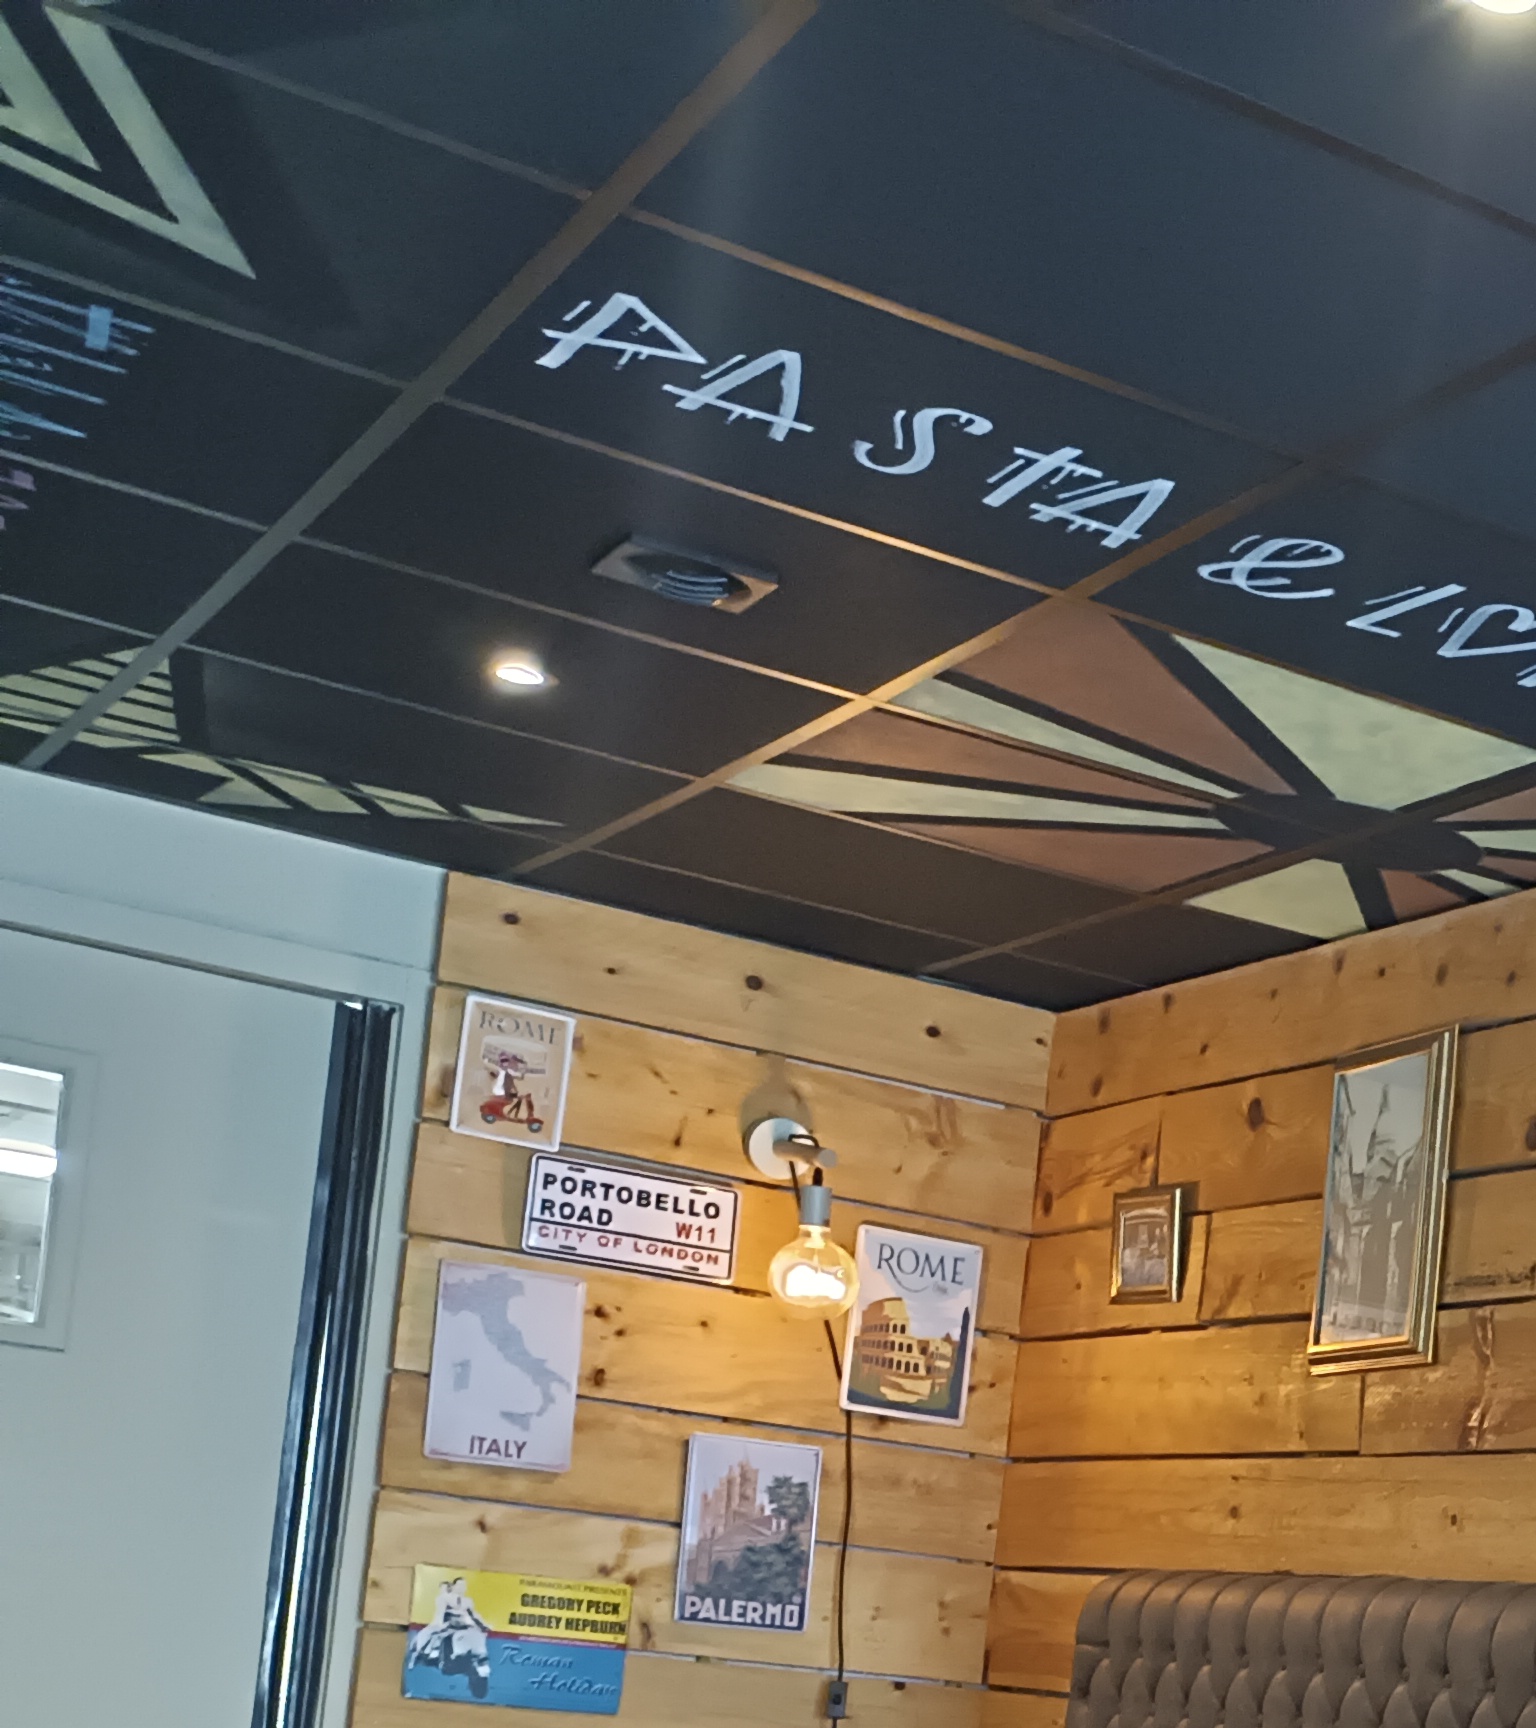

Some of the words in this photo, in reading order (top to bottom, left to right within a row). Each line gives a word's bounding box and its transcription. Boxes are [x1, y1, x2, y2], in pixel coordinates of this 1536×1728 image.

[479, 1010, 560, 1045] ROME
[542, 1172, 720, 1220] PORTOBELLO
[540, 1198, 613, 1227] ROAD
[538, 1225, 588, 1243] CITY
[597, 1234, 623, 1249] OF
[633, 1240, 719, 1266] LONDON
[675, 1221, 716, 1244] W11
[877, 1243, 966, 1290] ROME
[469, 1434, 528, 1459] ITALY
[520, 1592, 584, 1613] GREGORY
[586, 1599, 621, 1616] PECK
[684, 1595, 801, 1628] PALERMO
[508, 1611, 562, 1630] AUDREY
[564, 1617, 627, 1636] HEPBURN
[498, 1642, 574, 1669] Roman
